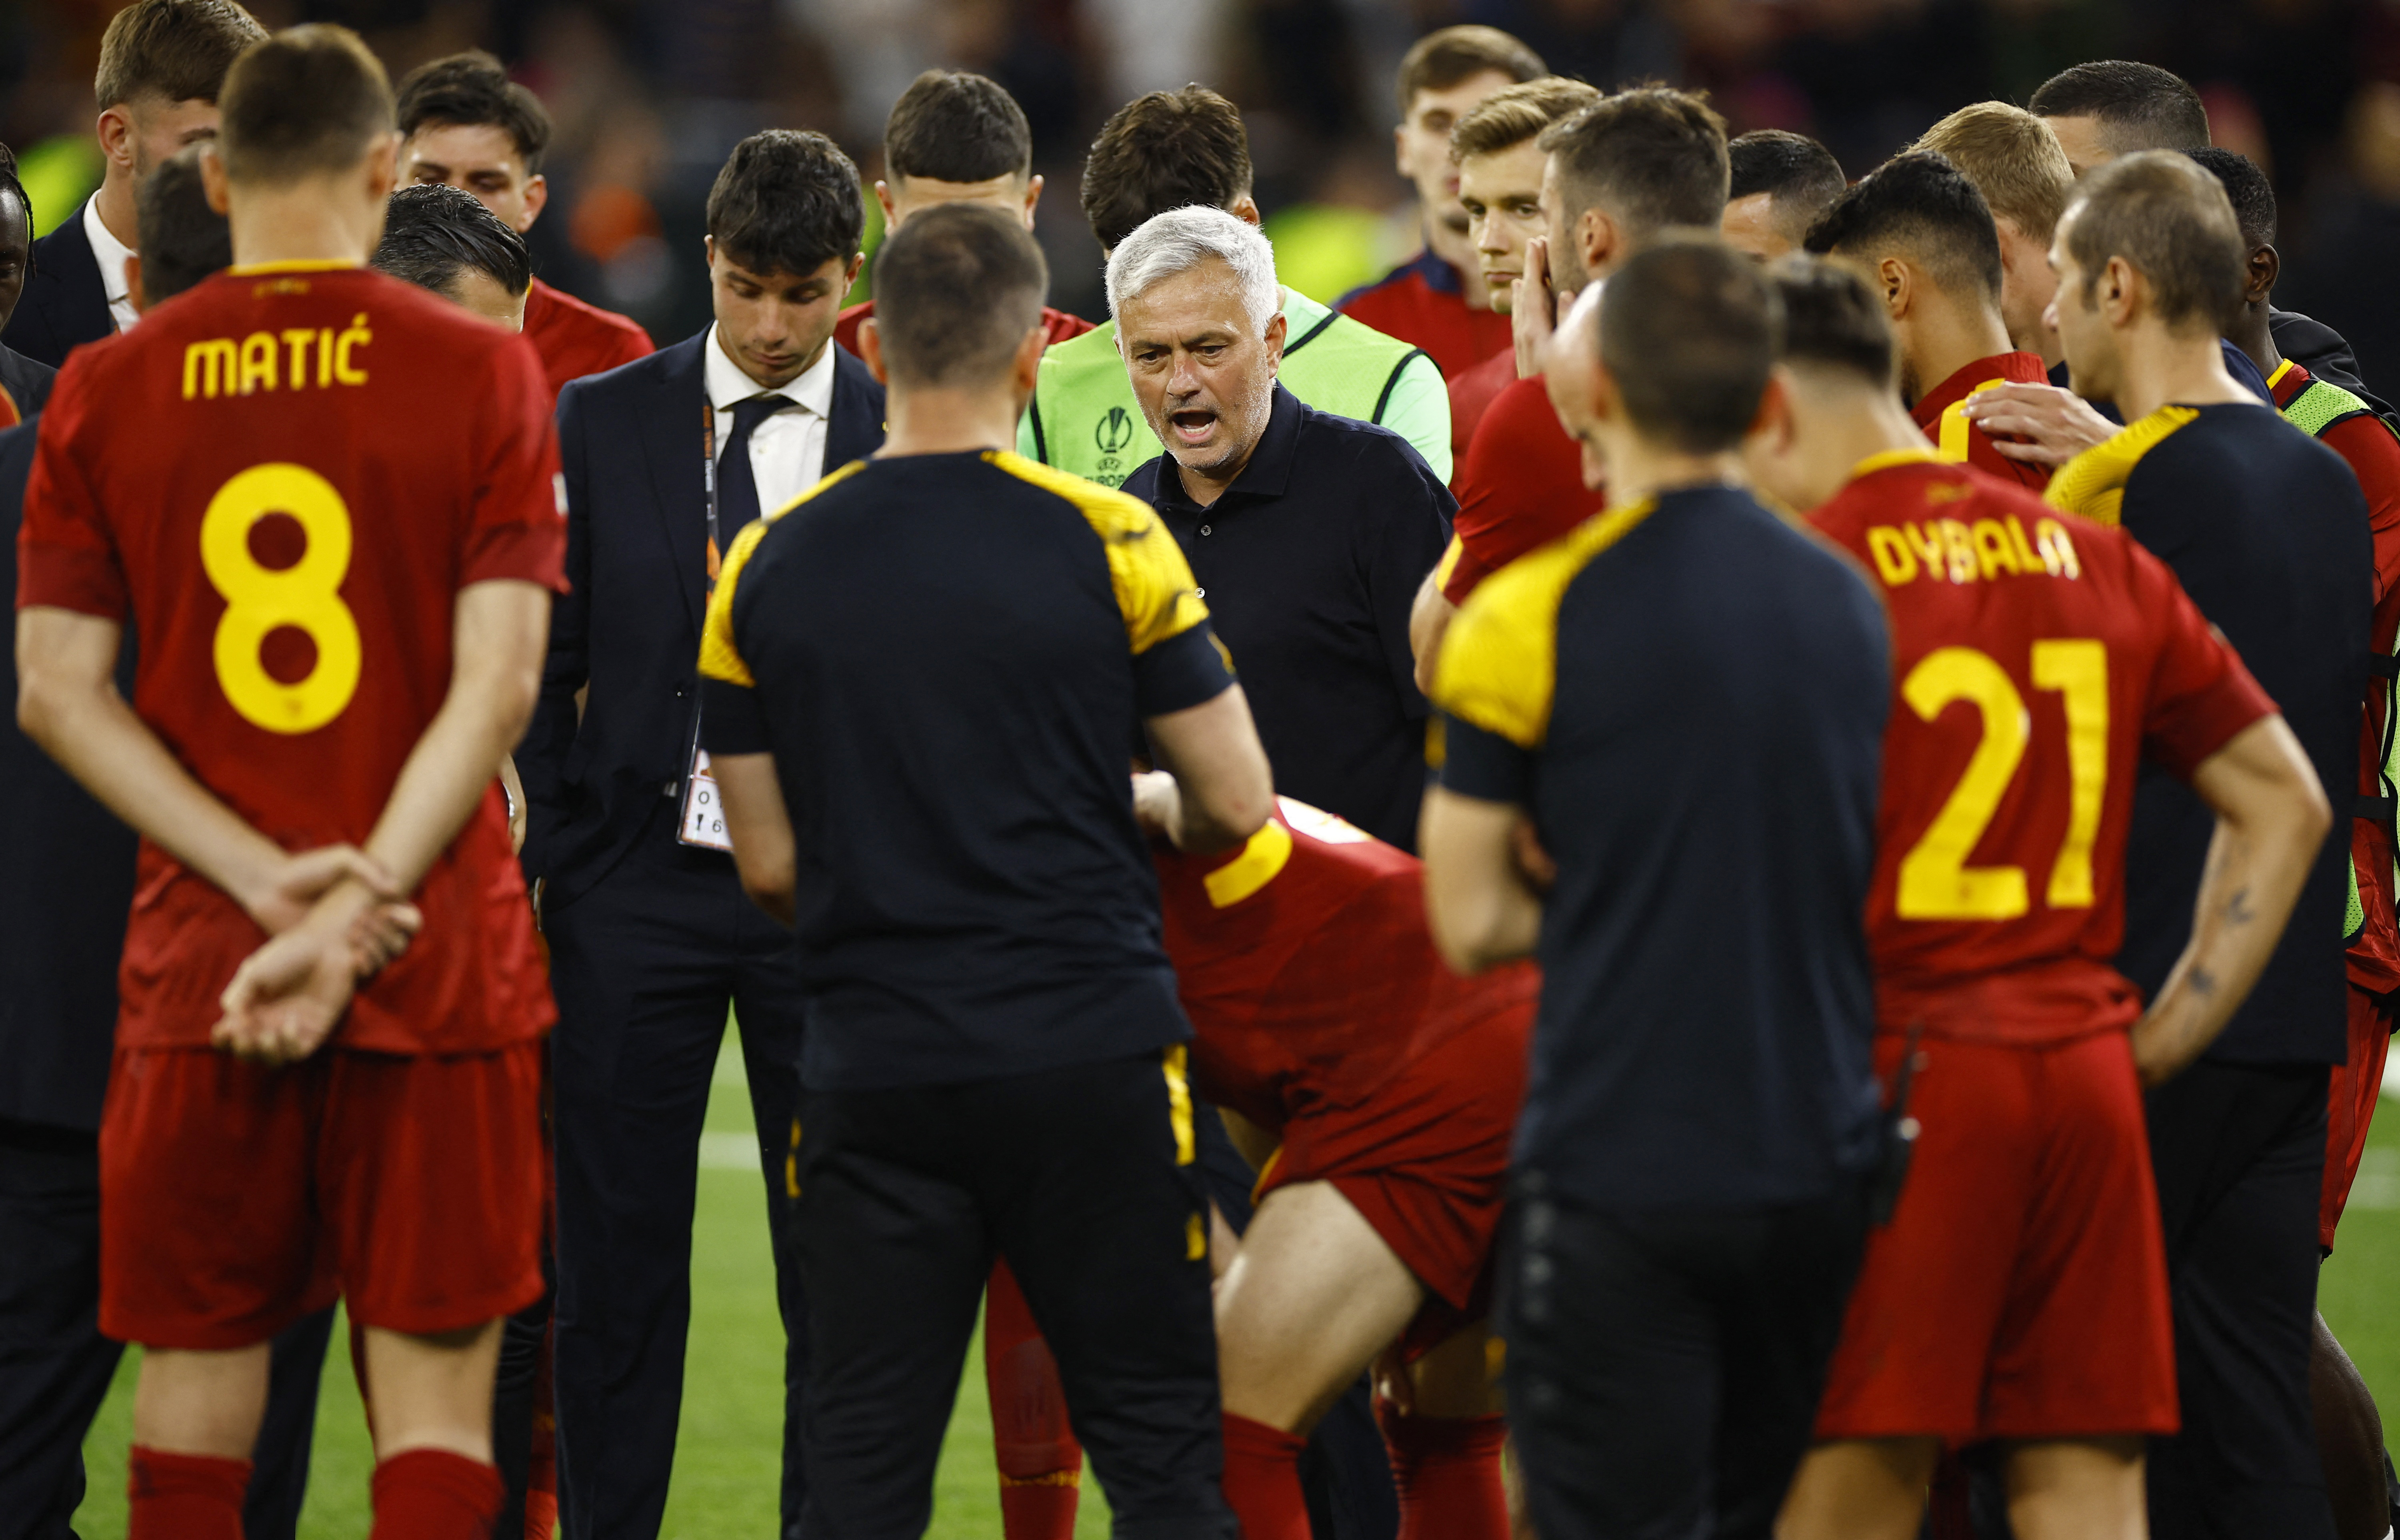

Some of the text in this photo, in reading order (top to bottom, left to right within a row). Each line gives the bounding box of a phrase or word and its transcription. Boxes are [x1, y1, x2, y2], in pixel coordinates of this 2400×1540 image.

[183, 312, 372, 399] MATIĆ
[1084, 474, 1125, 487] ROP
[1867, 513, 2080, 586] DYBALA
[200, 462, 362, 734] 8
[1897, 639, 2109, 921] 21
